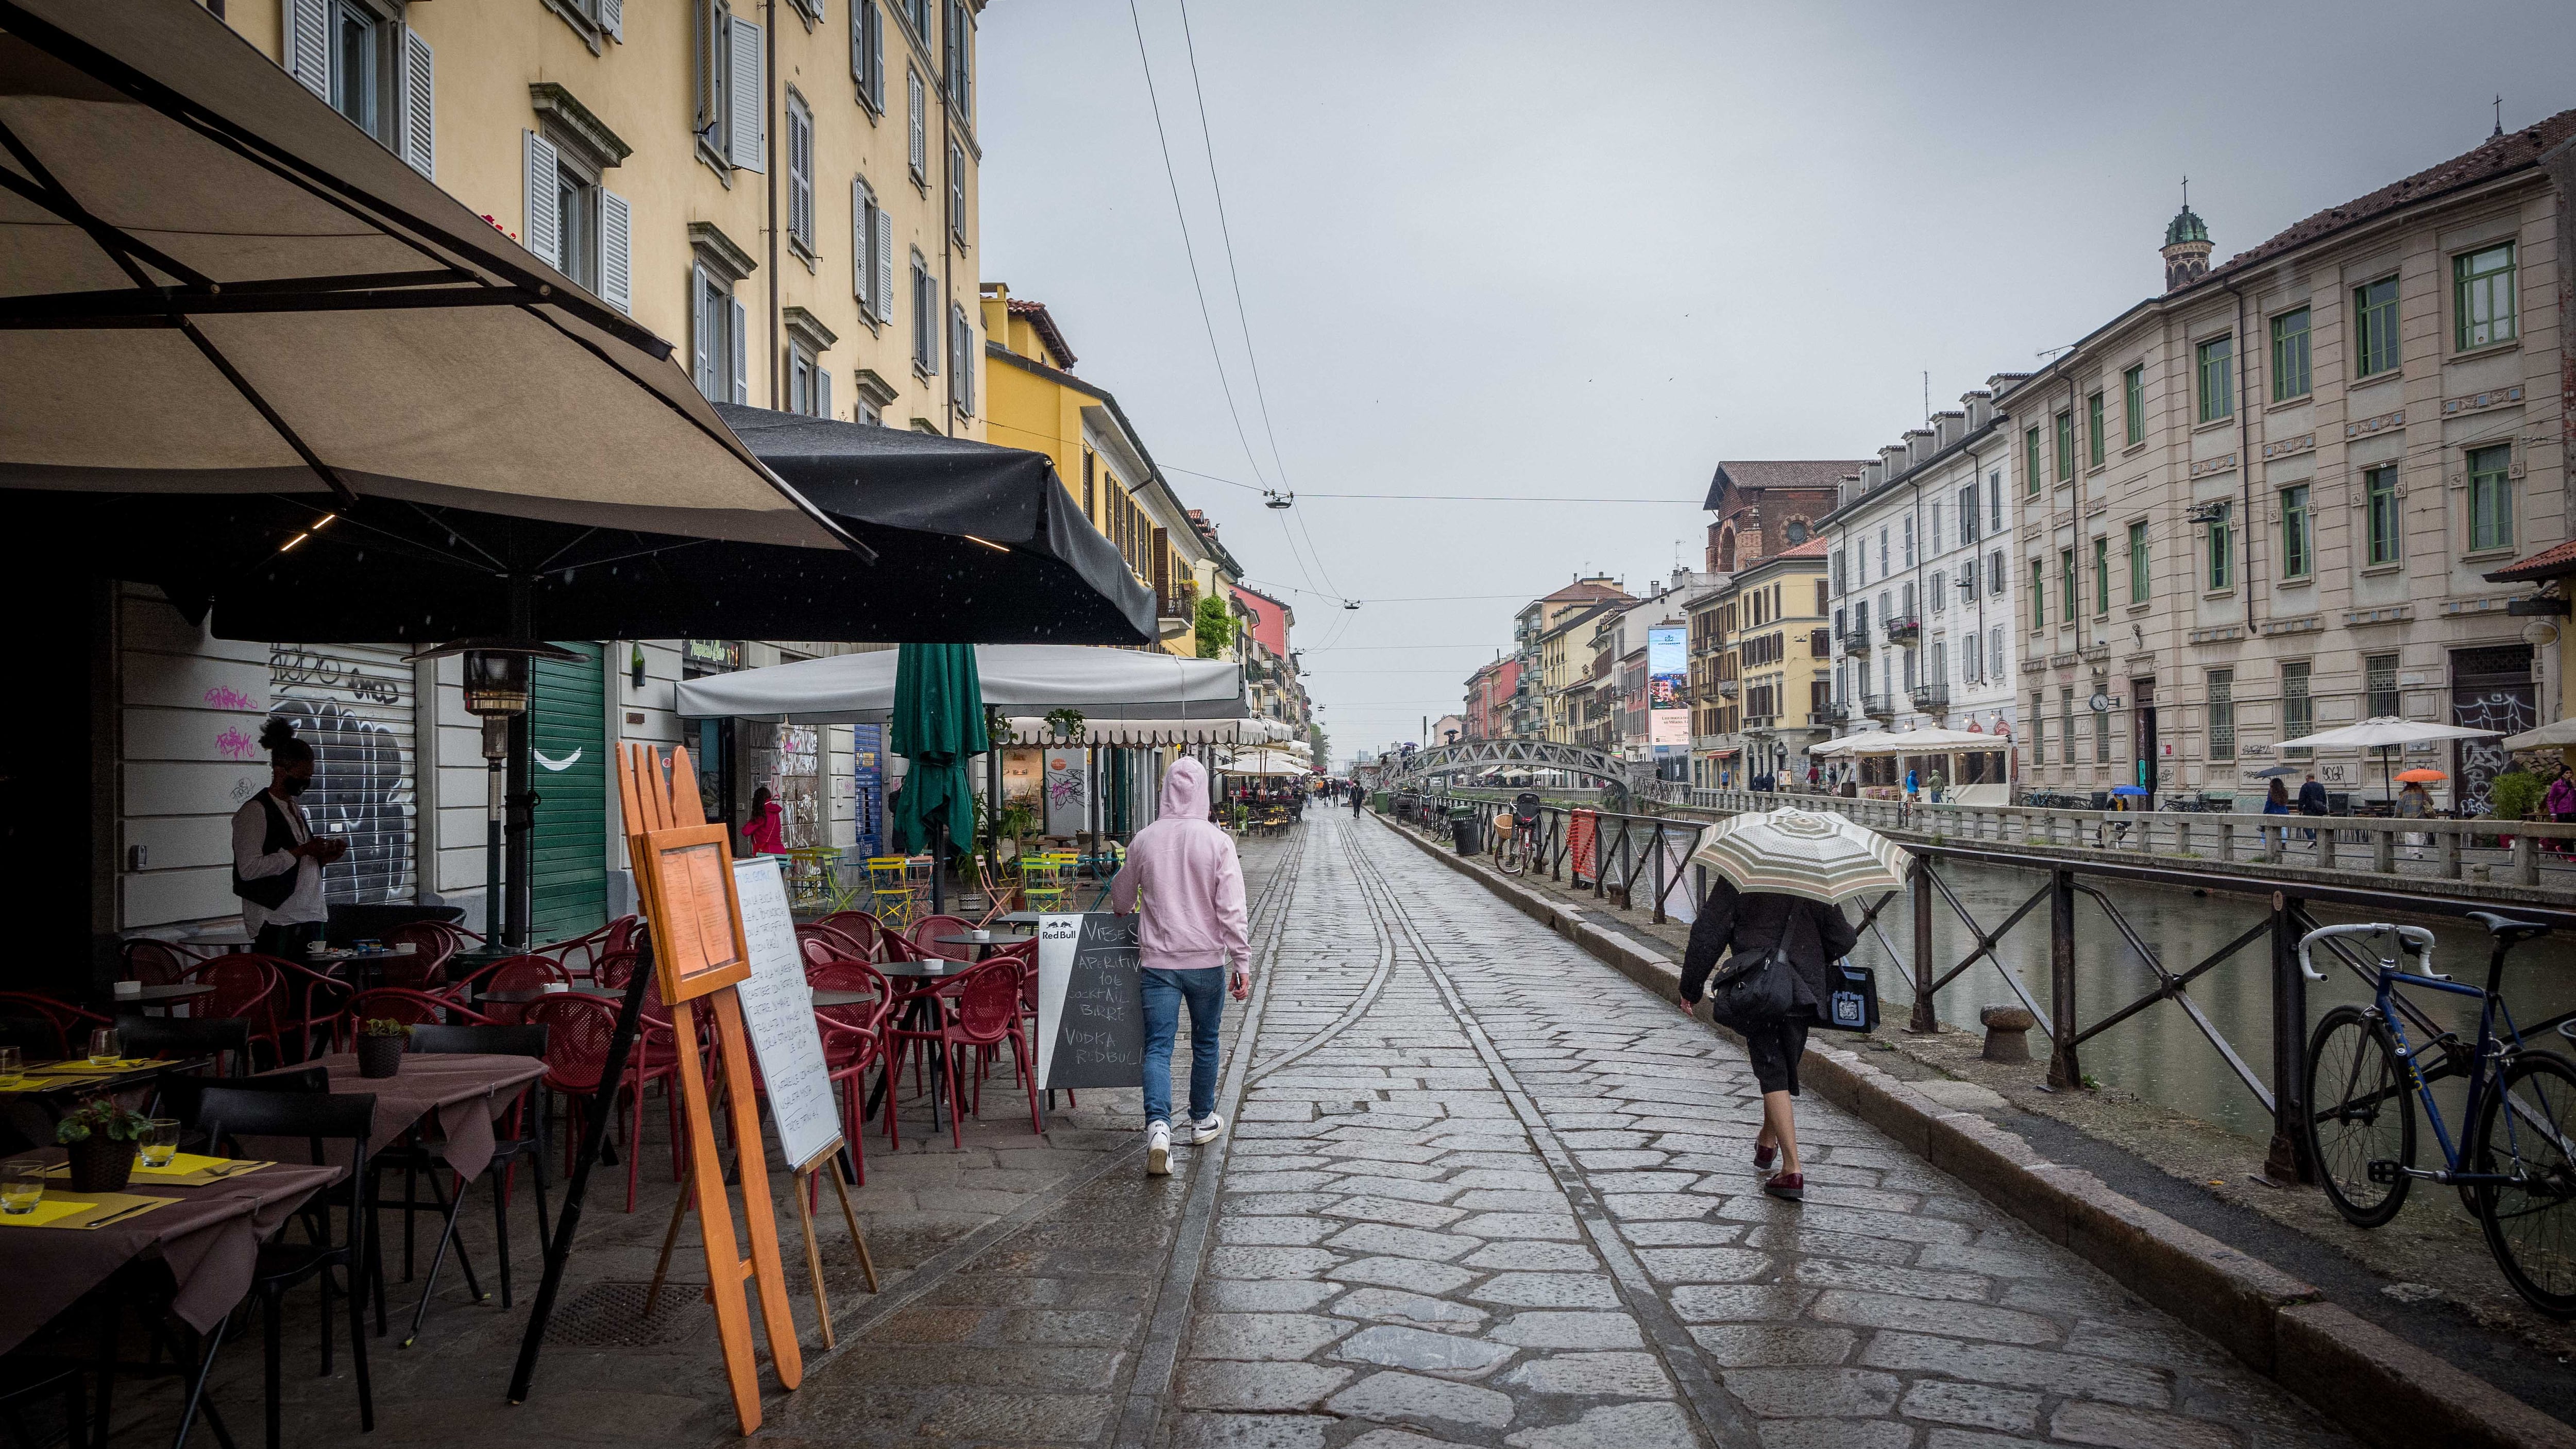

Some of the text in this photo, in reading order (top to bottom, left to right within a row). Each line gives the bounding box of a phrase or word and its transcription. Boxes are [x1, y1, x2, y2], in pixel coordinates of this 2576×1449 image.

[1042, 930, 1076, 940] Red Bull
[1079, 954, 1141, 973] APERITIV
[1065, 1028, 1115, 1047] VODKA
